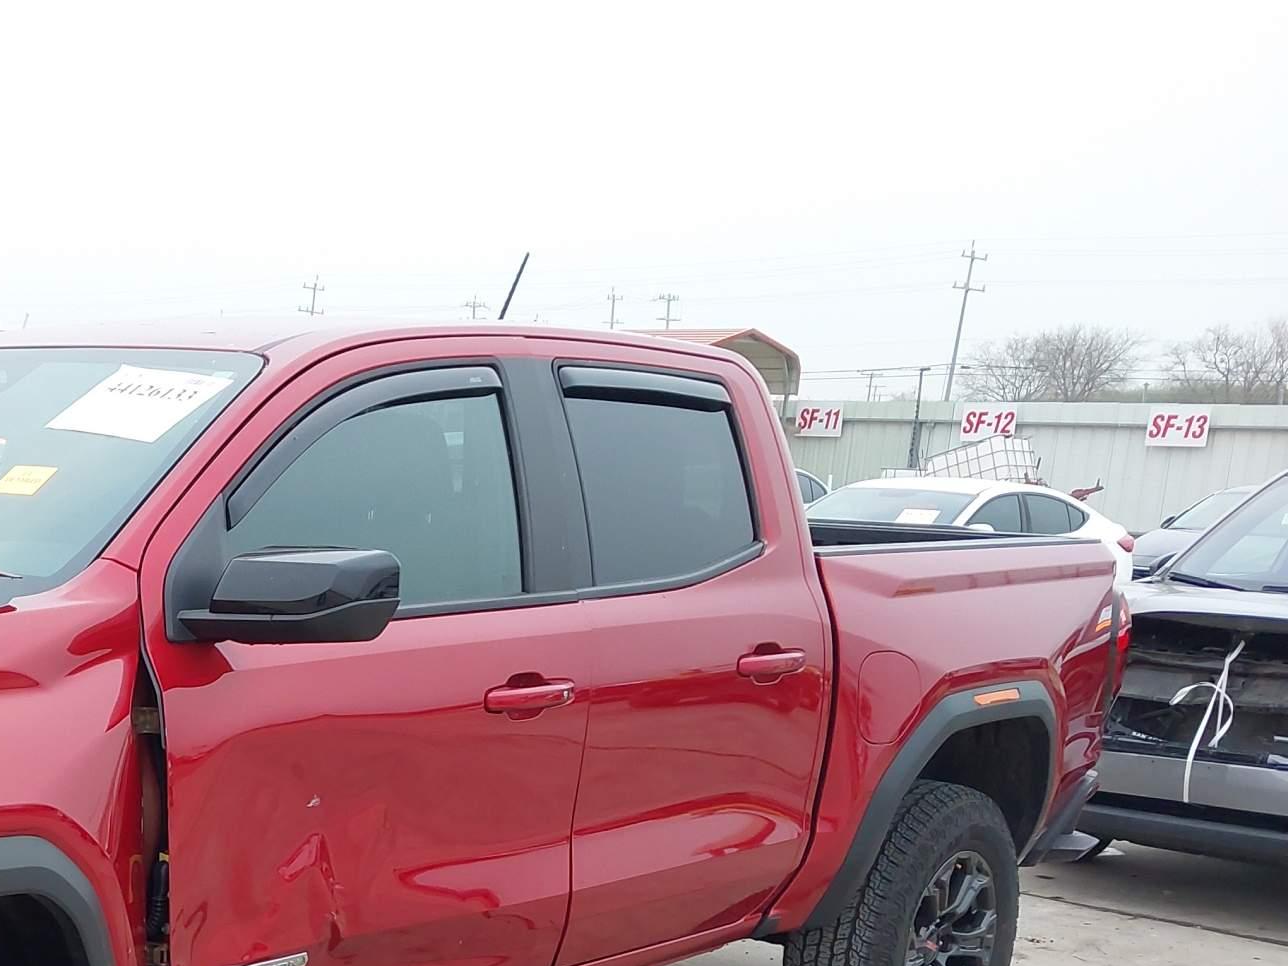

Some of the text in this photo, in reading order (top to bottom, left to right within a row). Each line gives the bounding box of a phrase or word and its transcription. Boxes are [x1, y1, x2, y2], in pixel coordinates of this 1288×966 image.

[797, 407, 840, 431] SF-11
[962, 411, 1016, 435] SF-12
[1147, 414, 1209, 439] SF-13
